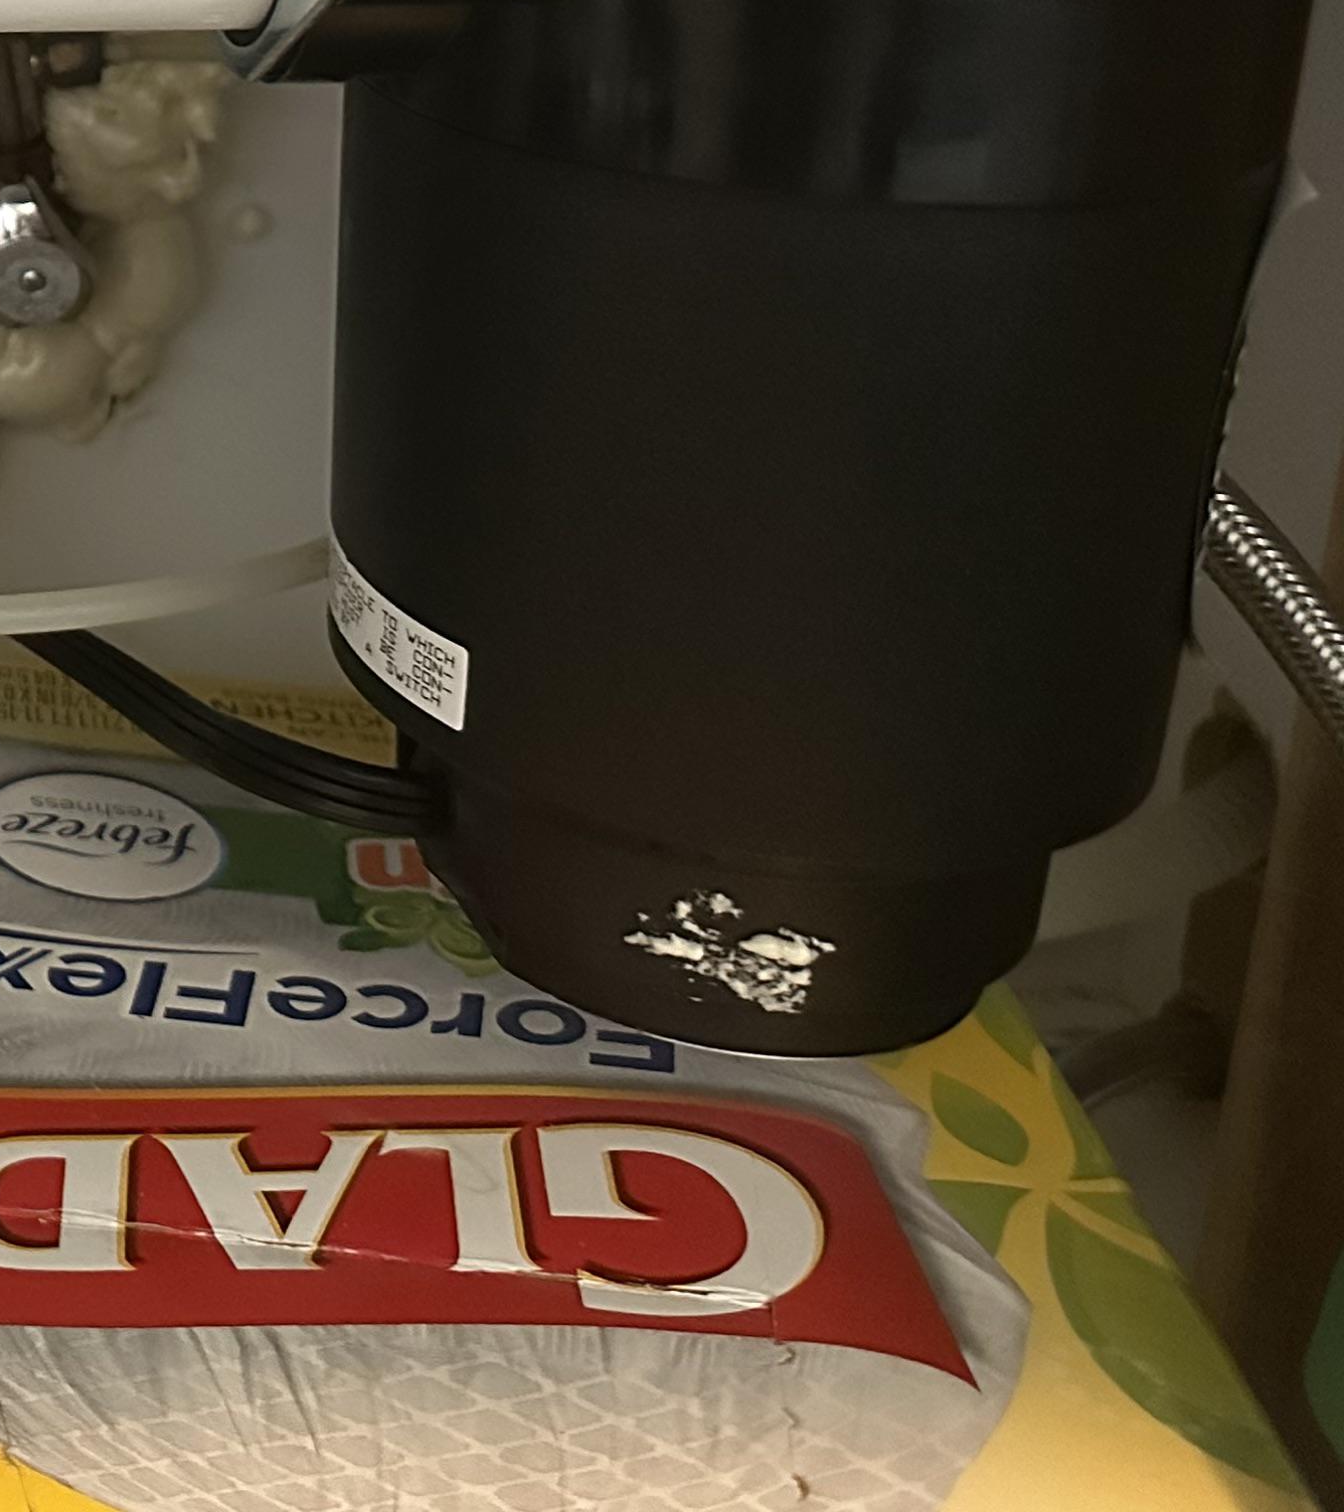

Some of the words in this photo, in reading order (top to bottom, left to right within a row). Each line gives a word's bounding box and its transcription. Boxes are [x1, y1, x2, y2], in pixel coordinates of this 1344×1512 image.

[382, 608, 398, 632] TO
[406, 627, 456, 670] WHICH
[384, 659, 442, 708] SWITCH
[412, 664, 454, 695] CON-
[413, 649, 455, 680] CON-
[28, 794, 168, 825] freshness
[0, 810, 198, 868] febreze
